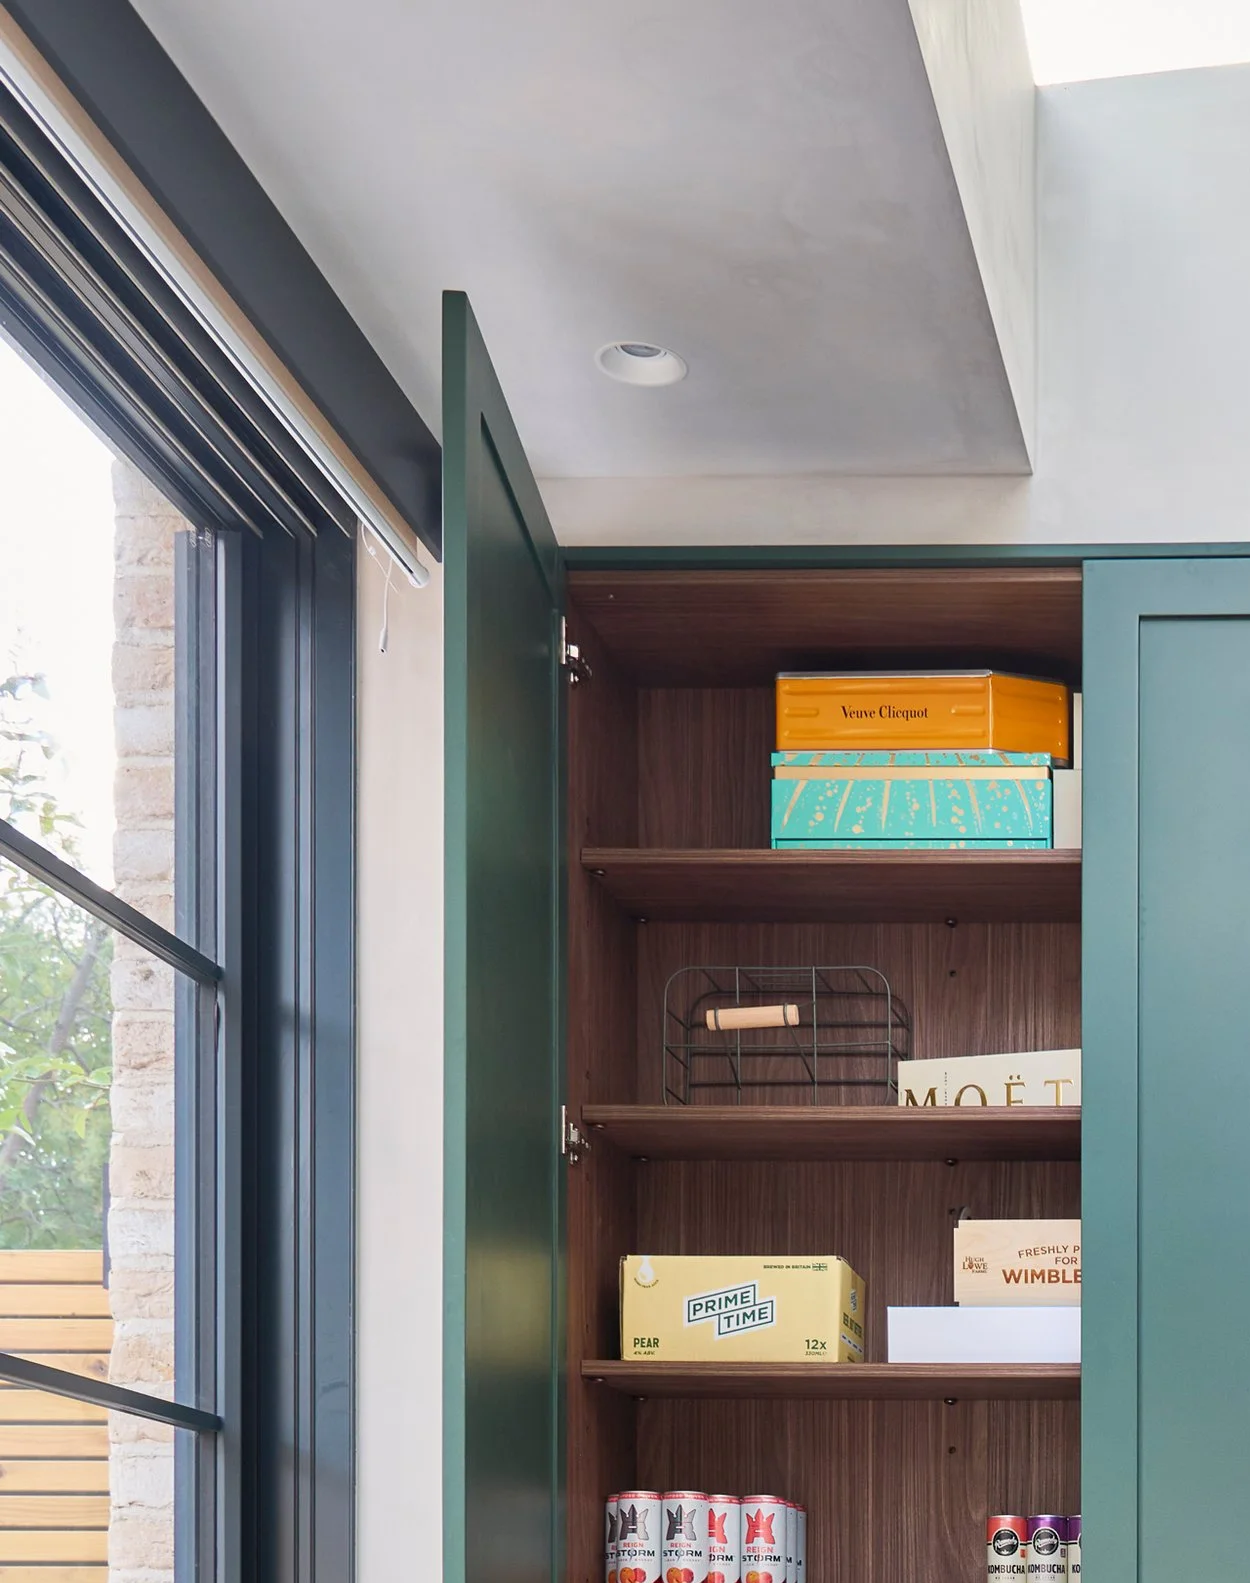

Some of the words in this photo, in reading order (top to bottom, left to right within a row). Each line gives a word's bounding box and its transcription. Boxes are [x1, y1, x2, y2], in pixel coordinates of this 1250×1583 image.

[841, 705, 876, 719] Veuve
[879, 704, 929, 721] Clicquot
[1018, 1245, 1070, 1259] FRESHLY
[1055, 1256, 1078, 1265] FOR
[1002, 1268, 1081, 1284] WIMBLE
[692, 1290, 751, 1316] PRIME
[723, 1306, 769, 1329] TIME
[633, 1337, 659, 1348] PEAR
[805, 1339, 827, 1350] 12x
[617, 1549, 655, 1560] STORM
[663, 1549, 703, 1560] STORM
[742, 1554, 781, 1562] STORM
[987, 1564, 1026, 1574] KOMBUCHA
[1028, 1564, 1066, 1574] KOMBUCHA
